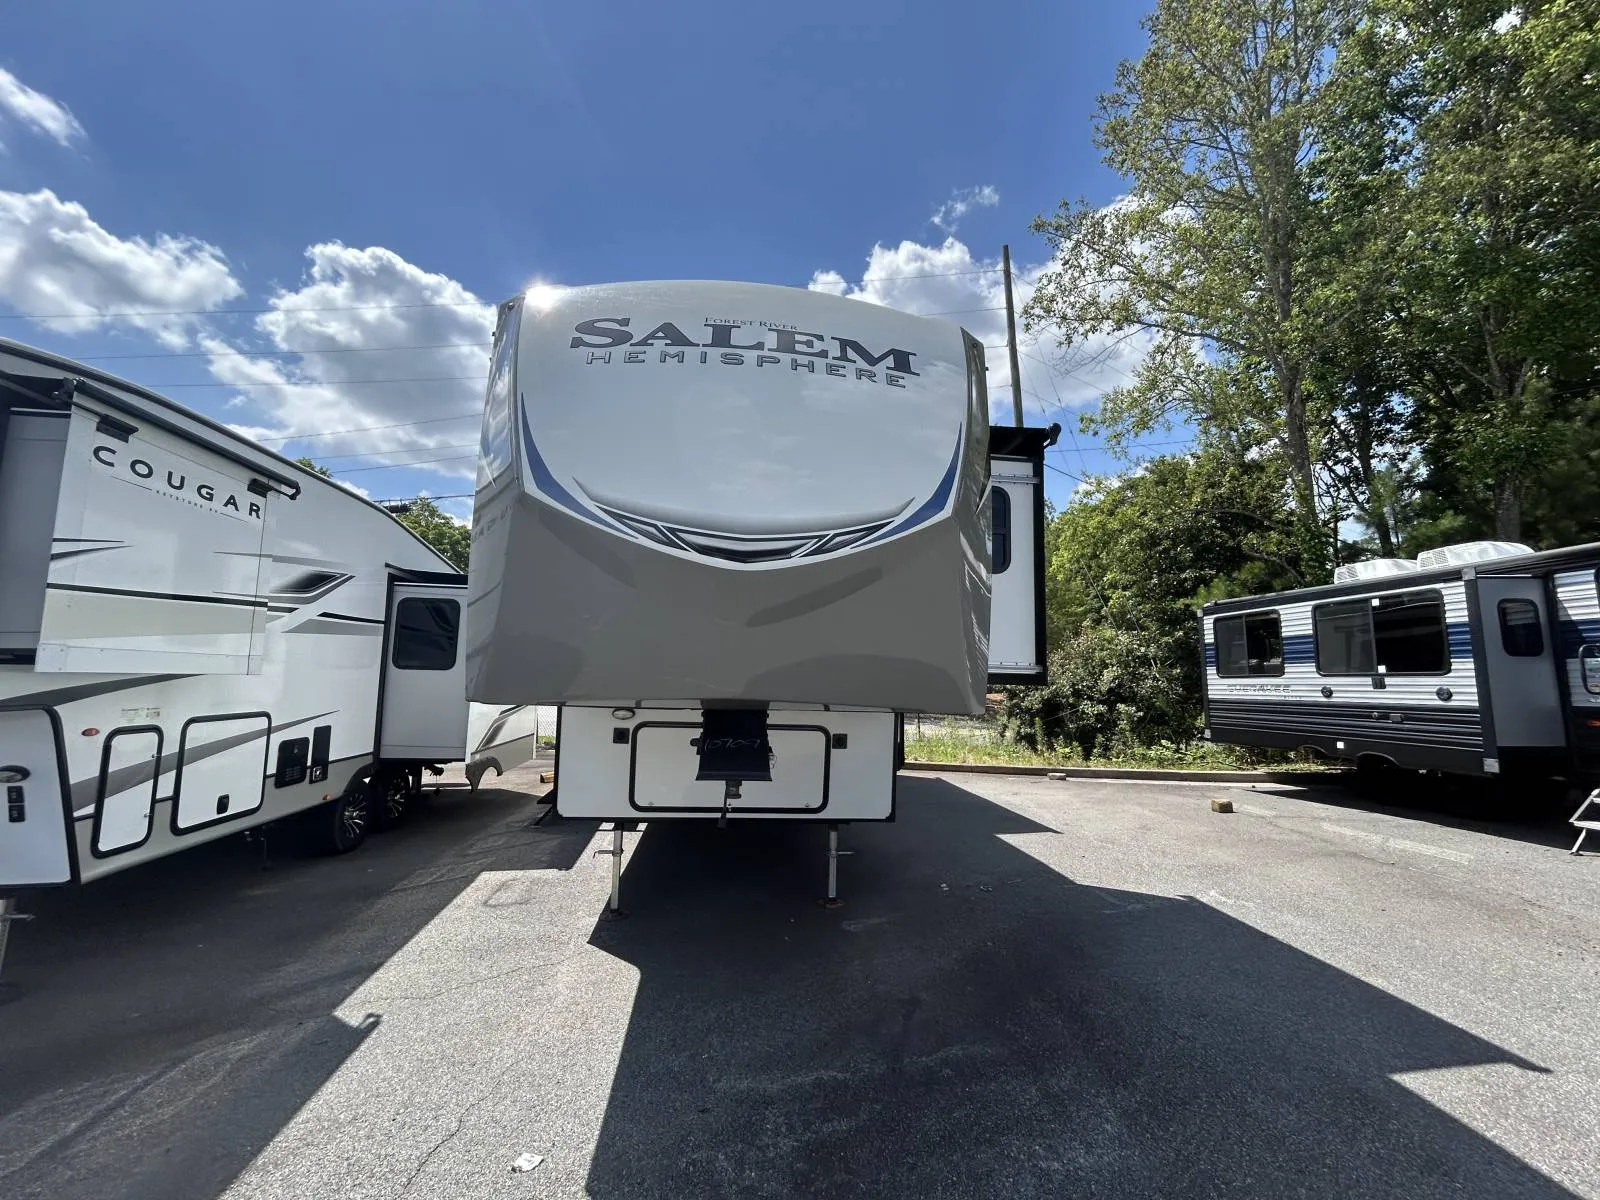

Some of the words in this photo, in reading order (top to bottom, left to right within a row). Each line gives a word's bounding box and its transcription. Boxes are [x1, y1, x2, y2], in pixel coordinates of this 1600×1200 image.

[570, 317, 921, 377] SALEM
[704, 317, 754, 326] FOREST
[759, 320, 799, 331] RIVER
[586, 350, 906, 389] HEMISPHERE
[92, 445, 262, 520] COUGAR
